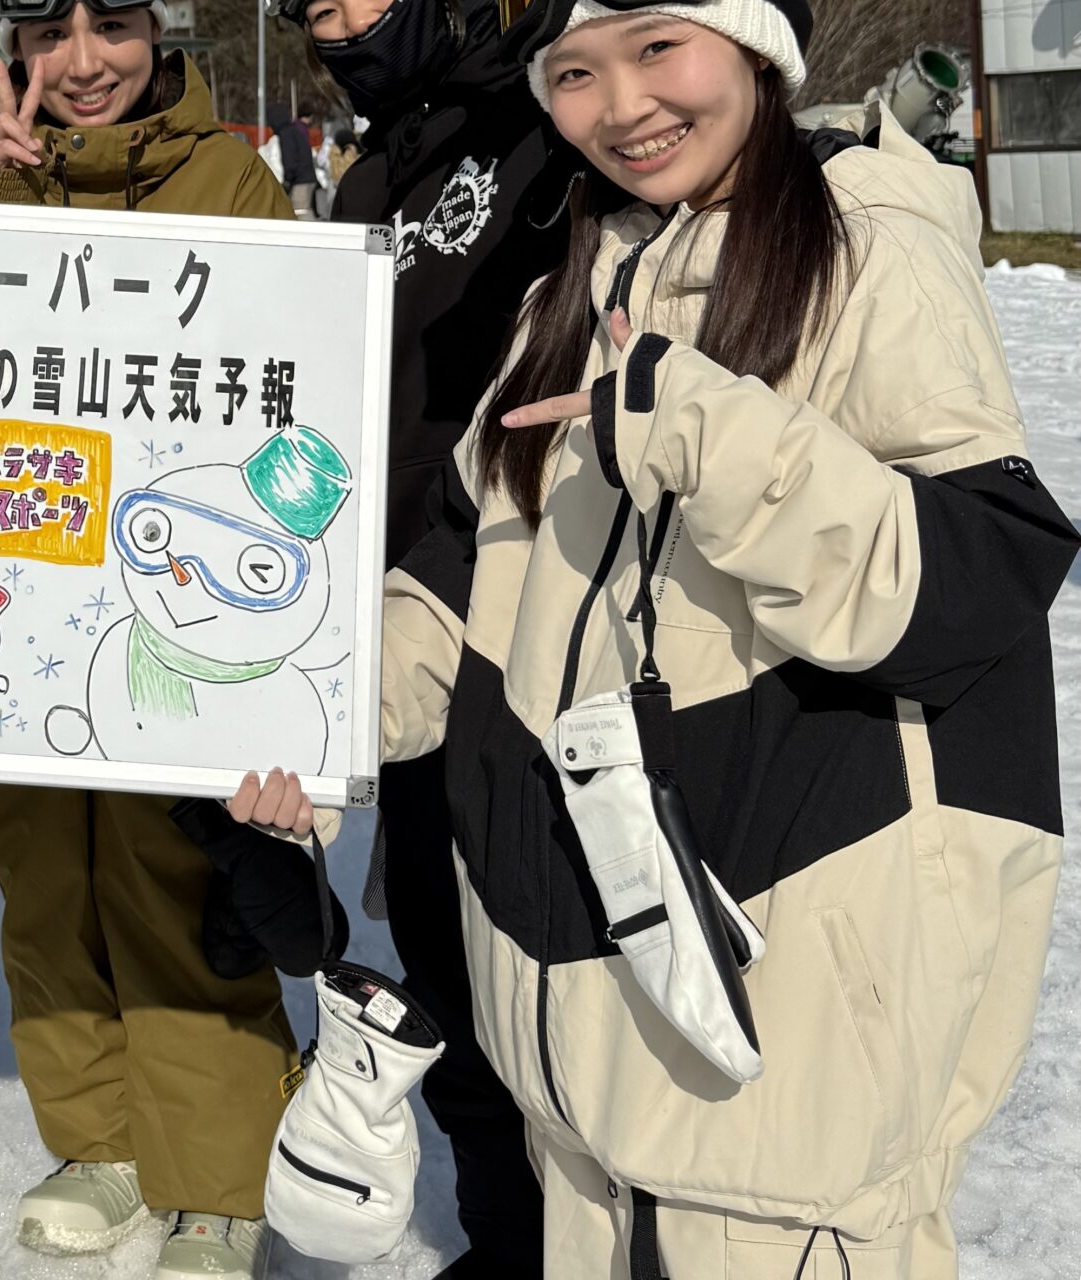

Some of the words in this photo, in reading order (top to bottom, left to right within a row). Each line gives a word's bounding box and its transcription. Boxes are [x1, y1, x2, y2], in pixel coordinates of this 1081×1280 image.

[441, 190, 472, 211] made
[442, 208, 454, 222] in
[443, 209, 474, 235] japan
[394, 254, 417, 281] pan
